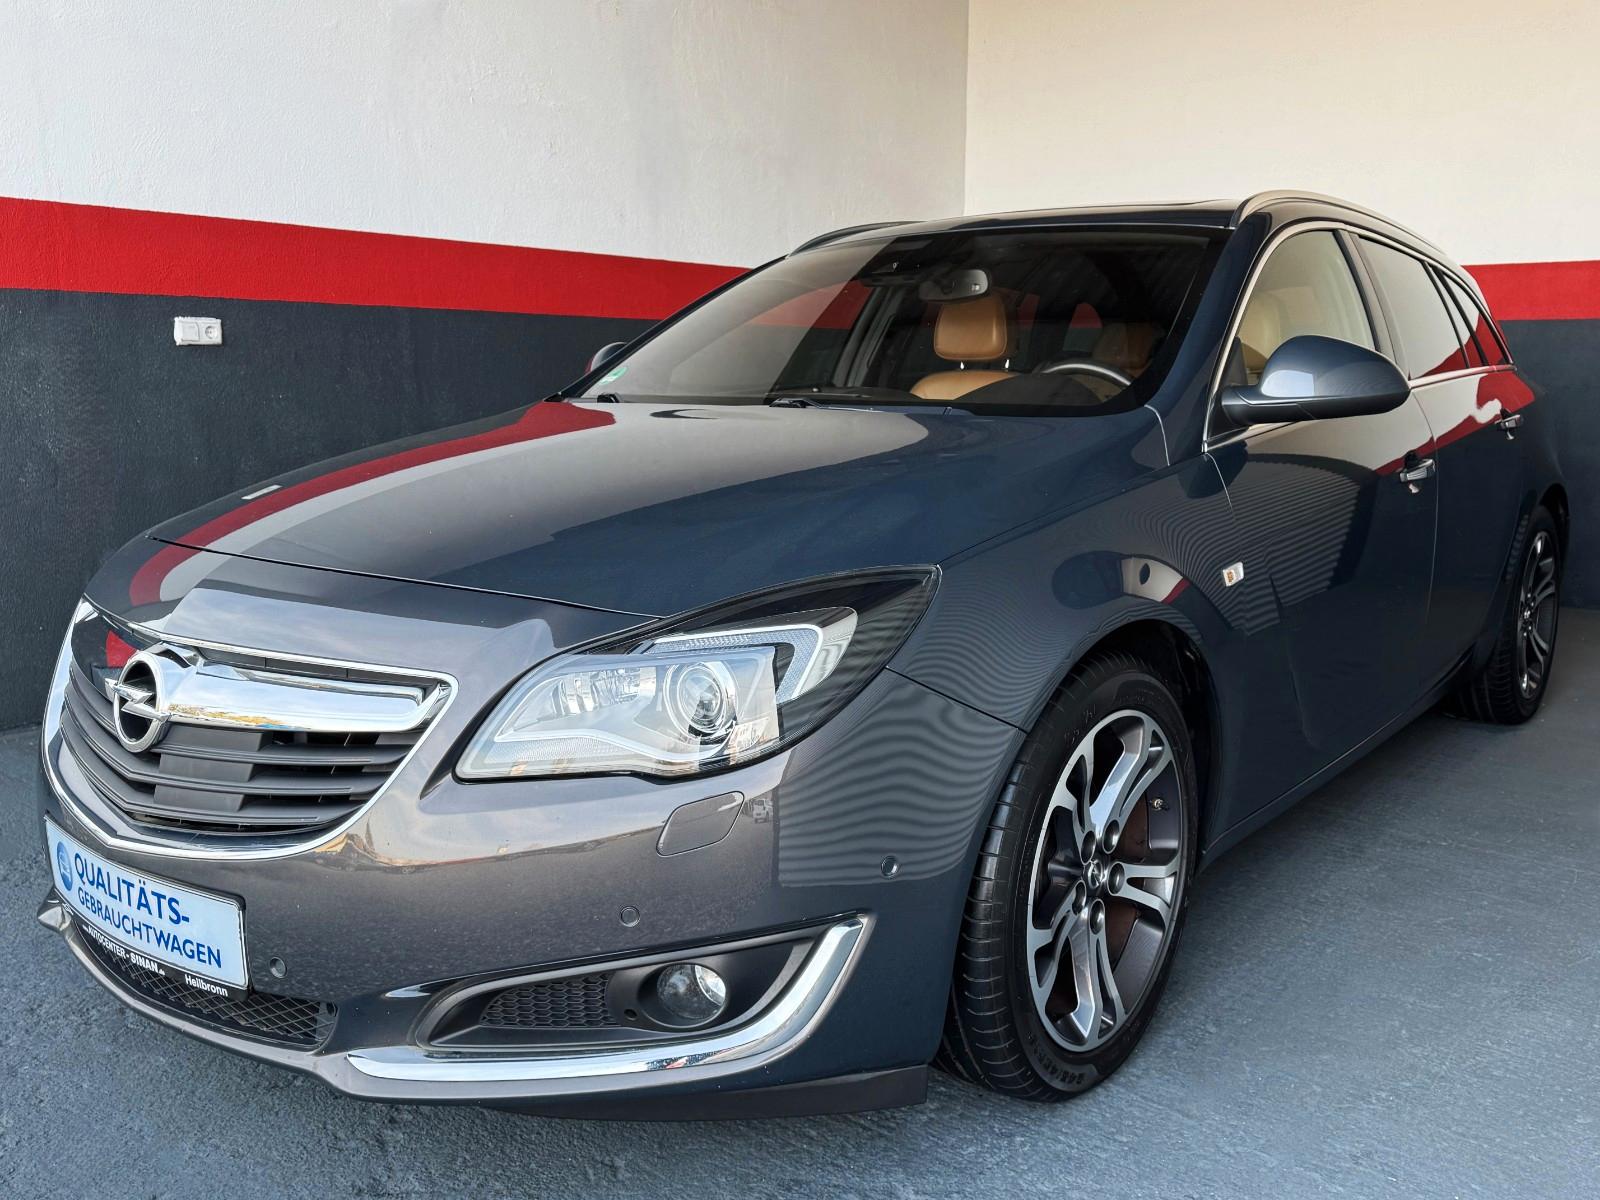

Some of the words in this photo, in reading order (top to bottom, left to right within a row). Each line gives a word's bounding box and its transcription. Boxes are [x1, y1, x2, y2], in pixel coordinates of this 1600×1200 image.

[74, 852, 190, 925] QUALITÄTS-
[77, 888, 222, 969] GEBRAUCHTWAGEN
[184, 973, 229, 998] Heilbronn
